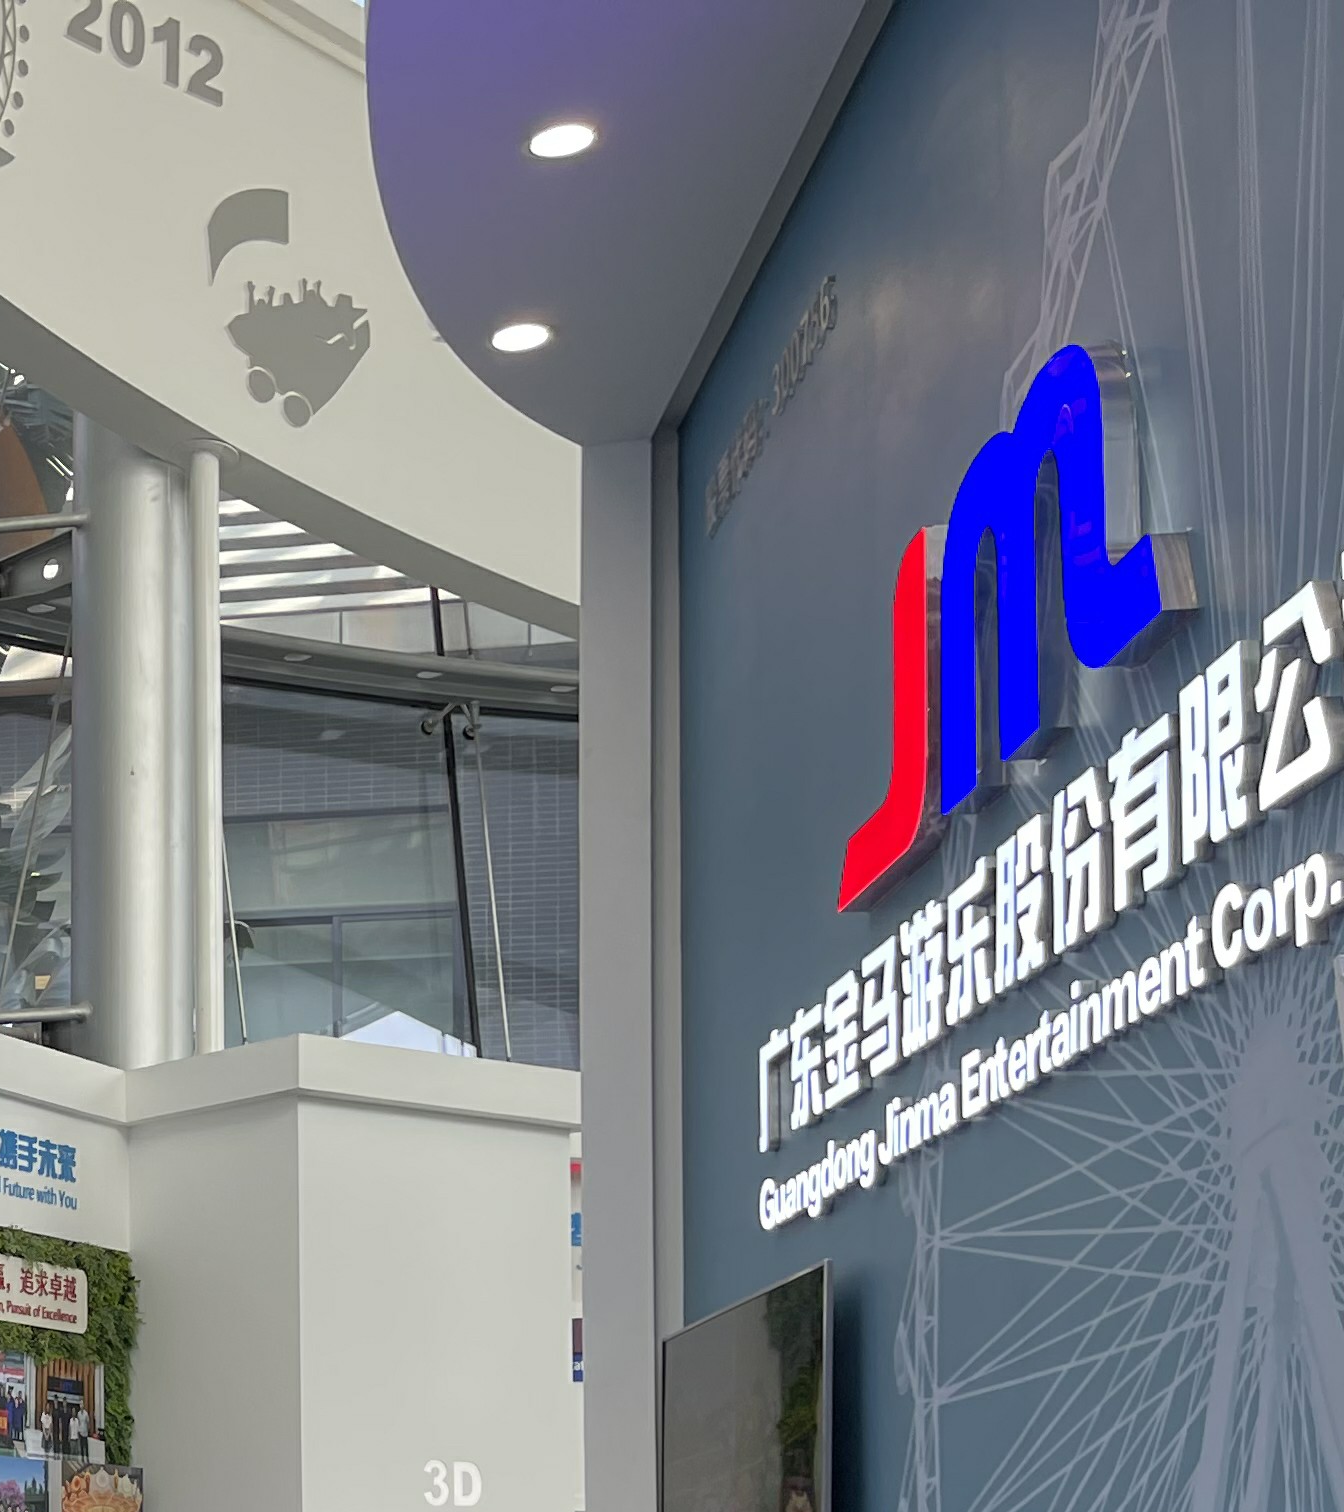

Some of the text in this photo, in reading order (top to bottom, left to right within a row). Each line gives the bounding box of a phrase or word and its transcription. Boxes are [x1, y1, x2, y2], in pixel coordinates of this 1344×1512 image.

[65, 0, 224, 106] 2012
[758, 551, 1344, 1153] 广东金马游乐股份有限公
[759, 854, 1341, 1231] Guangdong Jinma Entertainment Corp.
[4, 1178, 34, 1200] Future
[36, 1186, 56, 1204] with
[59, 1190, 77, 1209] You
[423, 1460, 482, 1506] 3D
